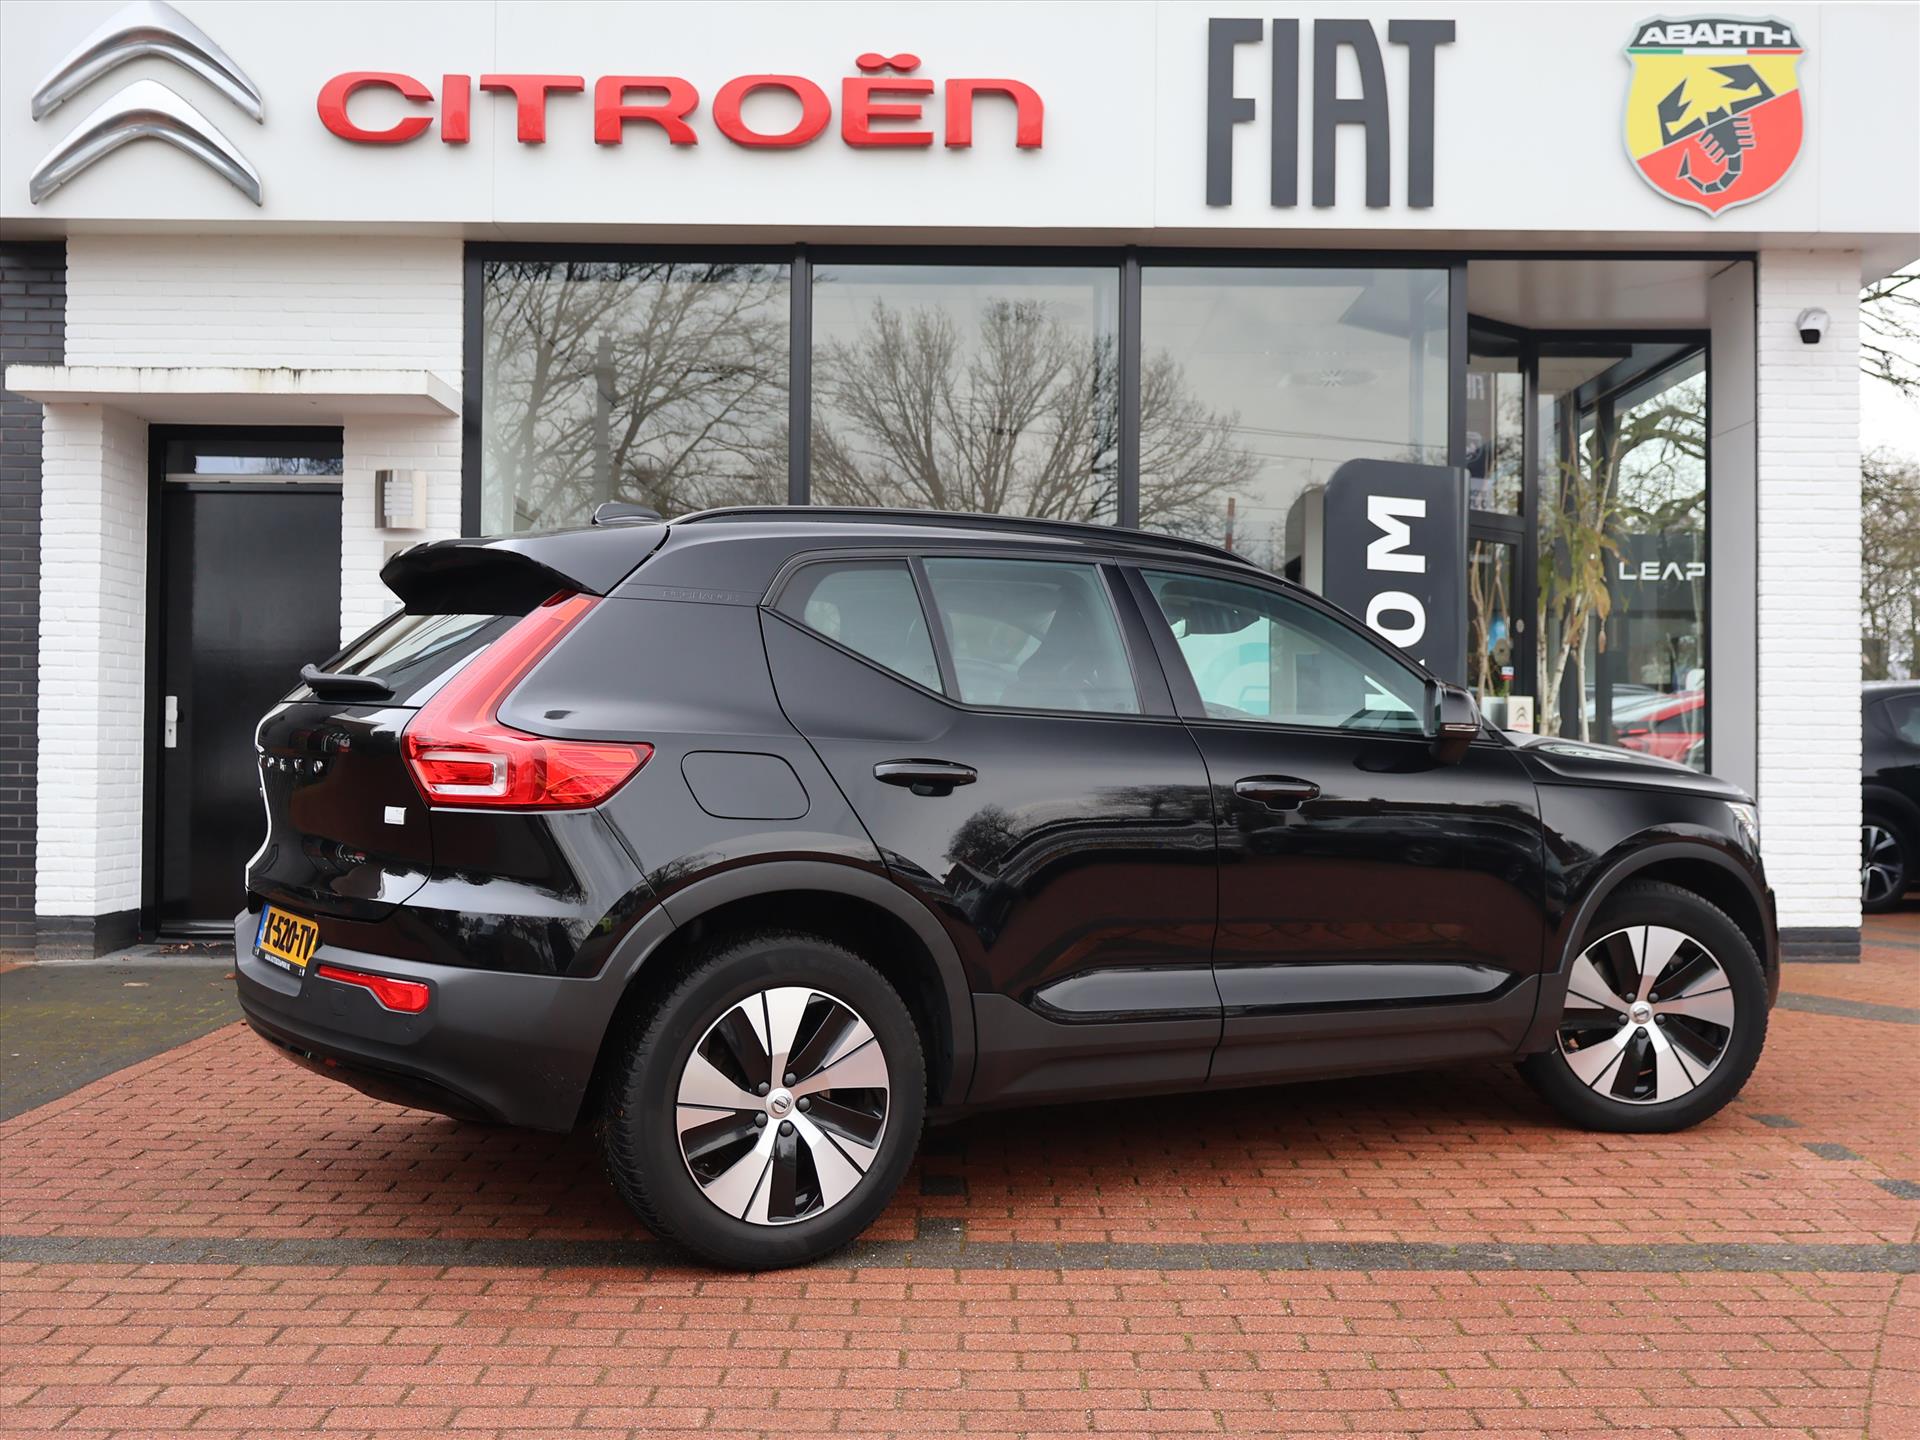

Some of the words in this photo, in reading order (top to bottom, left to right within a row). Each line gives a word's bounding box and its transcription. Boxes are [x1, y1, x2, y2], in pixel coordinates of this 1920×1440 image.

[1638, 22, 1792, 46] ABARTH
[316, 52, 1045, 150] CITROËN
[1206, 18, 1456, 208] FIAT
[1619, 561, 1706, 581] LEAP
